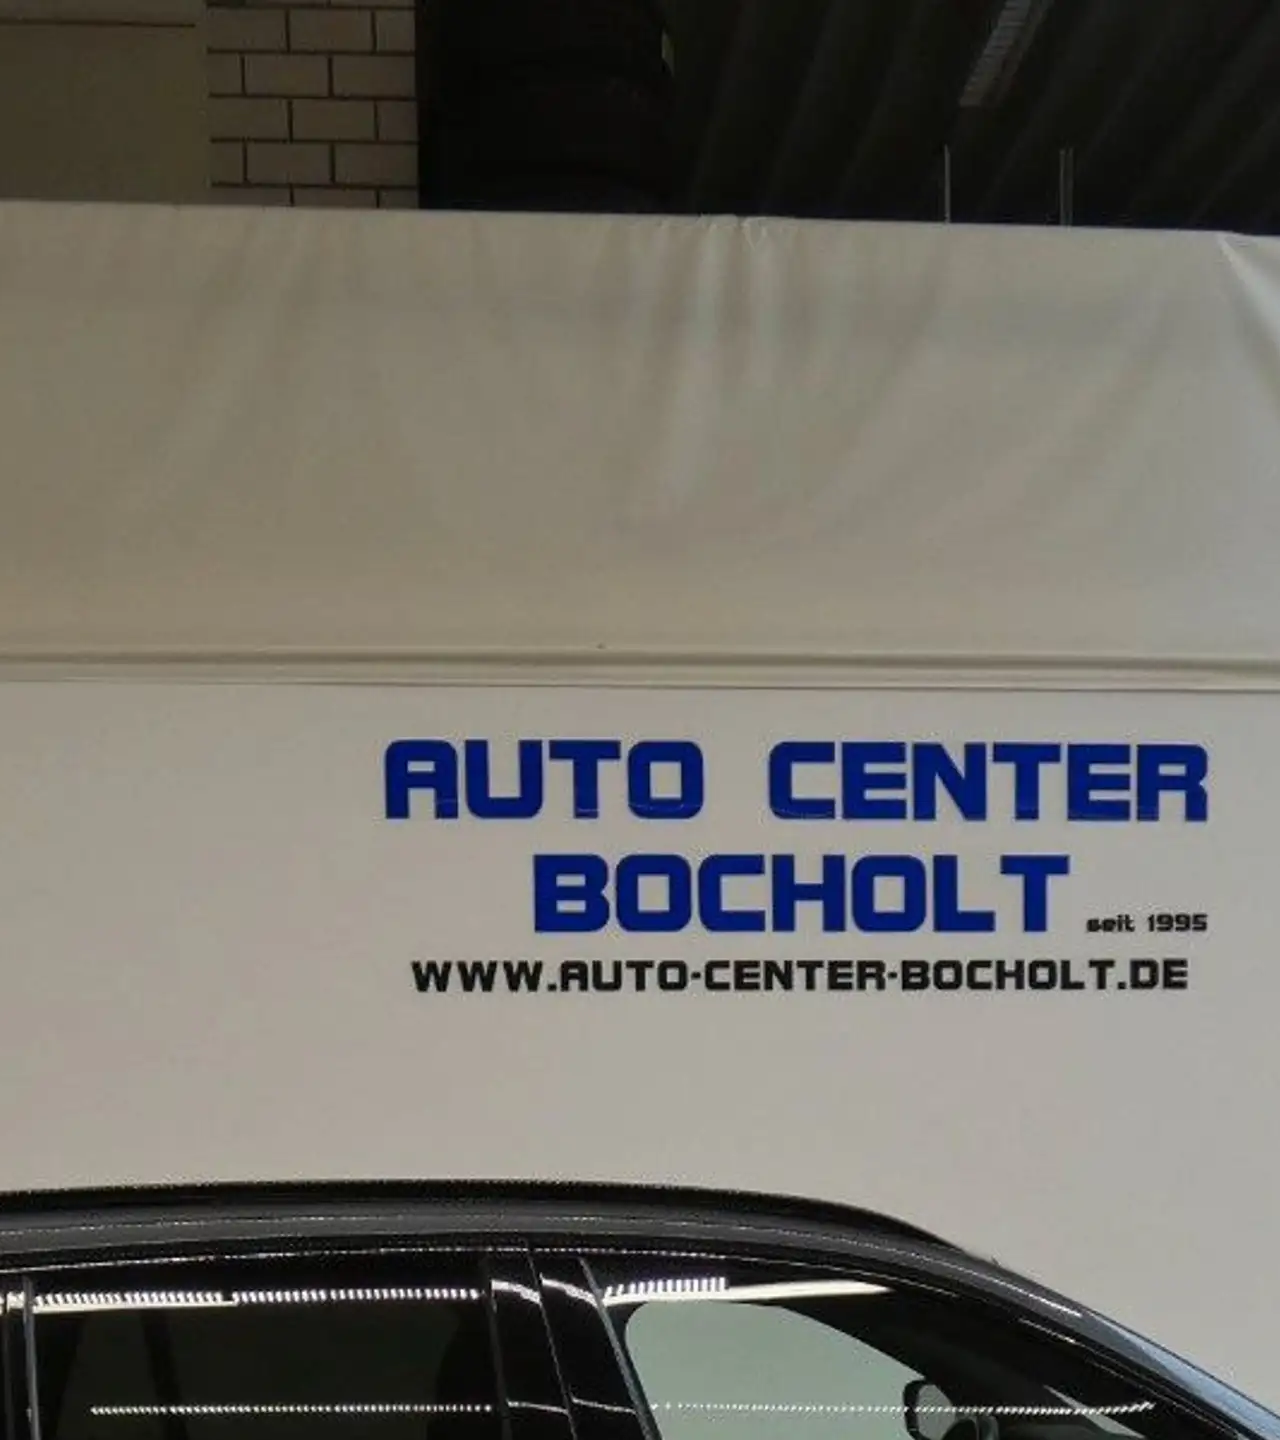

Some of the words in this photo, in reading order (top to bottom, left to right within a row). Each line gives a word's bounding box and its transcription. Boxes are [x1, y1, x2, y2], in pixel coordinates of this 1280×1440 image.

[384, 739, 705, 820] AUTO
[769, 741, 1209, 822] CENTER
[533, 853, 1071, 934] BOCHOLT
[1085, 913, 1136, 933] seit
[1147, 912, 1209, 932] 1995
[410, 957, 1189, 994] WWW.AUTO-CENTER-BOCHOLT.DE
